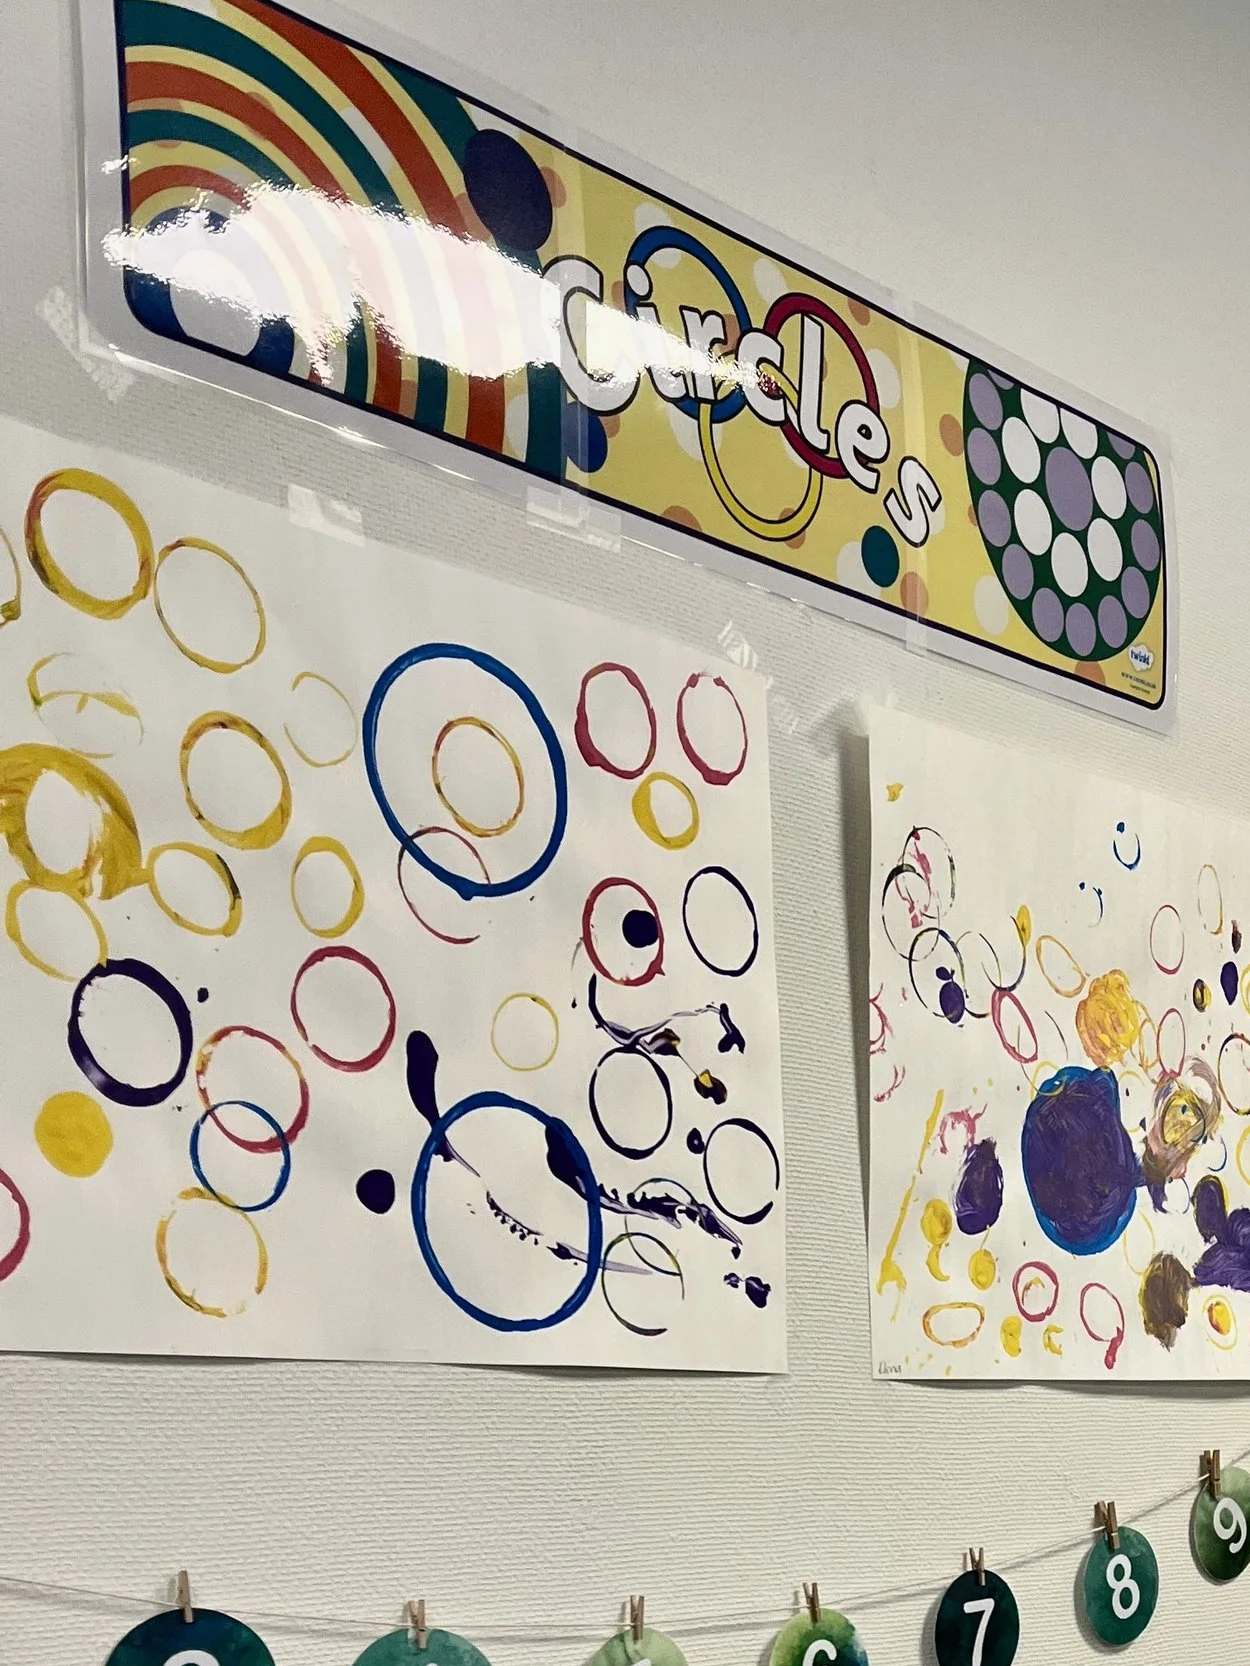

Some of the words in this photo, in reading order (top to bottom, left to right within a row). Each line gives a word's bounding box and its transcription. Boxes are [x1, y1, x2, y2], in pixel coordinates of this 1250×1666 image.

[541, 255, 942, 548] Circles
[1212, 1496, 1247, 1554] 9
[1106, 1553, 1140, 1620] 8
